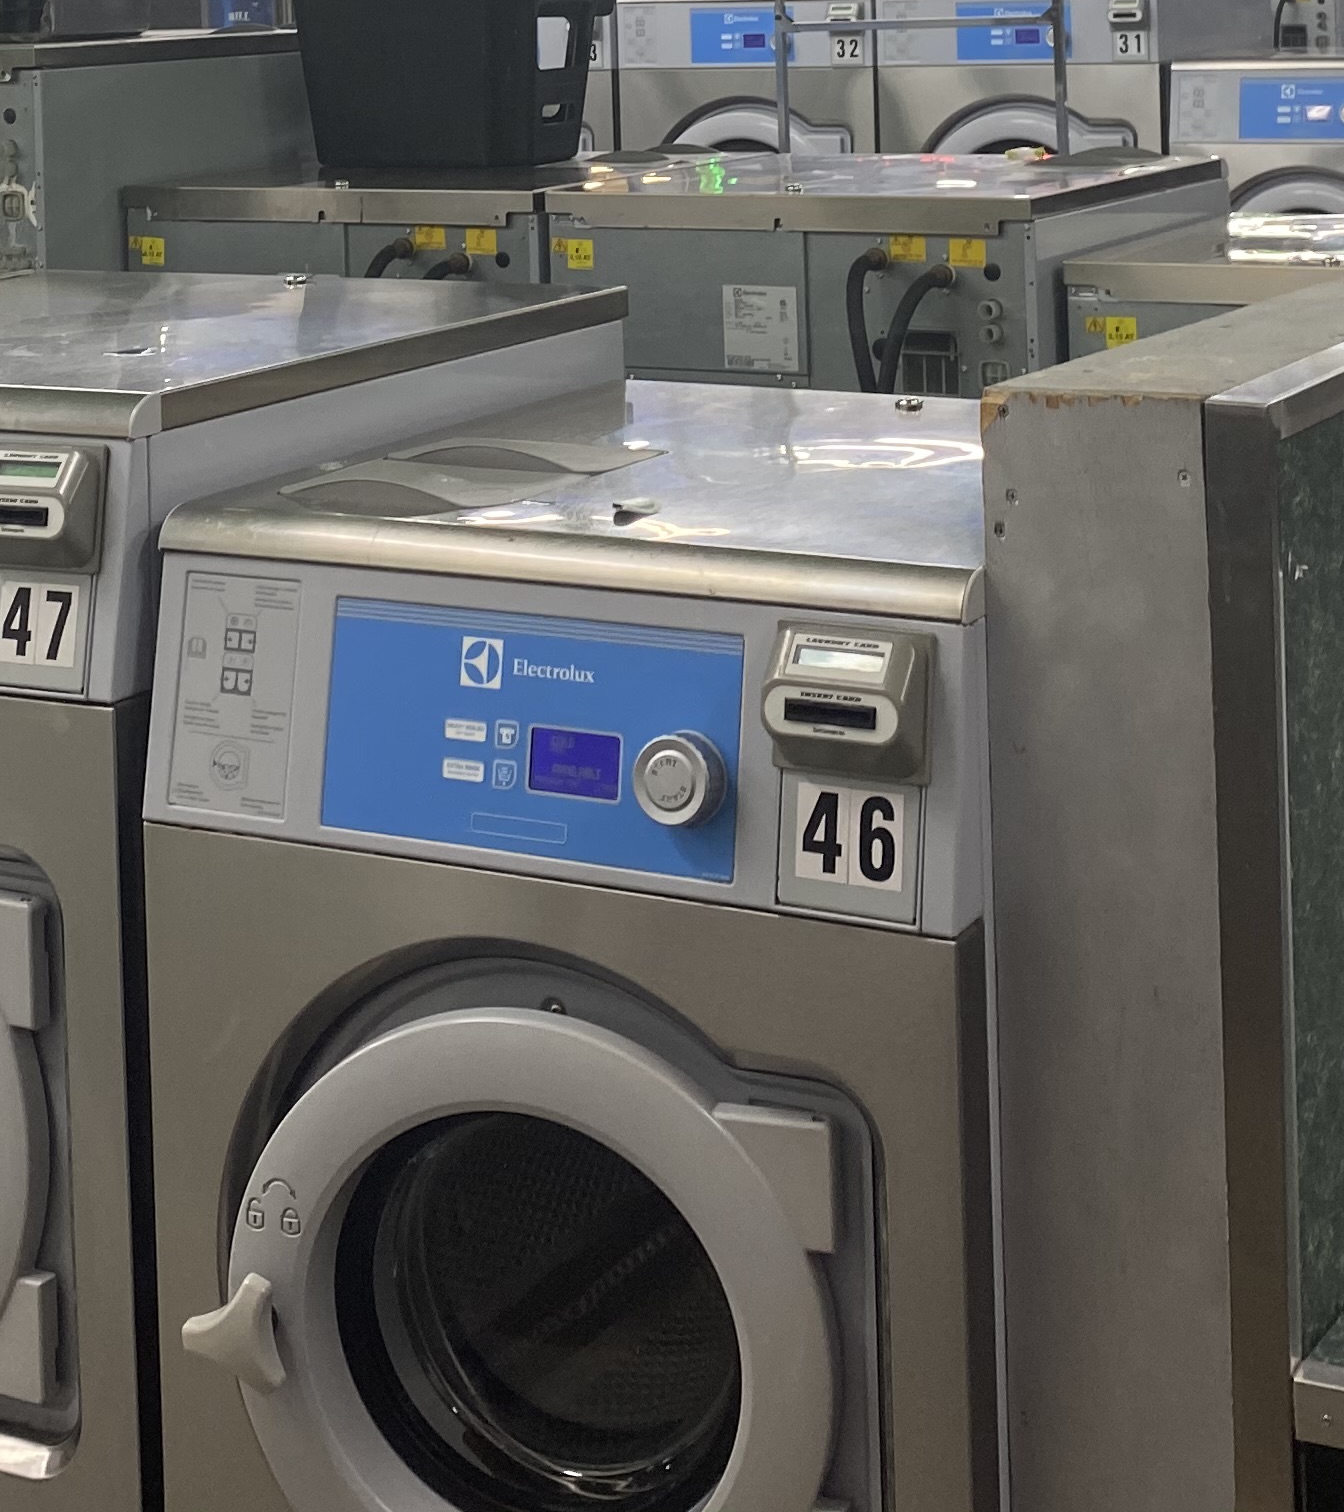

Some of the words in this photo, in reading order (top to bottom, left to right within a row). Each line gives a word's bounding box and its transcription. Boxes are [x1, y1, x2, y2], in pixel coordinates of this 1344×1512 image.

[836, 39, 859, 58] 32
[1119, 34, 1142, 54] 31
[2, 587, 73, 661] 47
[513, 658, 595, 683] Electrolux
[802, 791, 896, 883] 46
